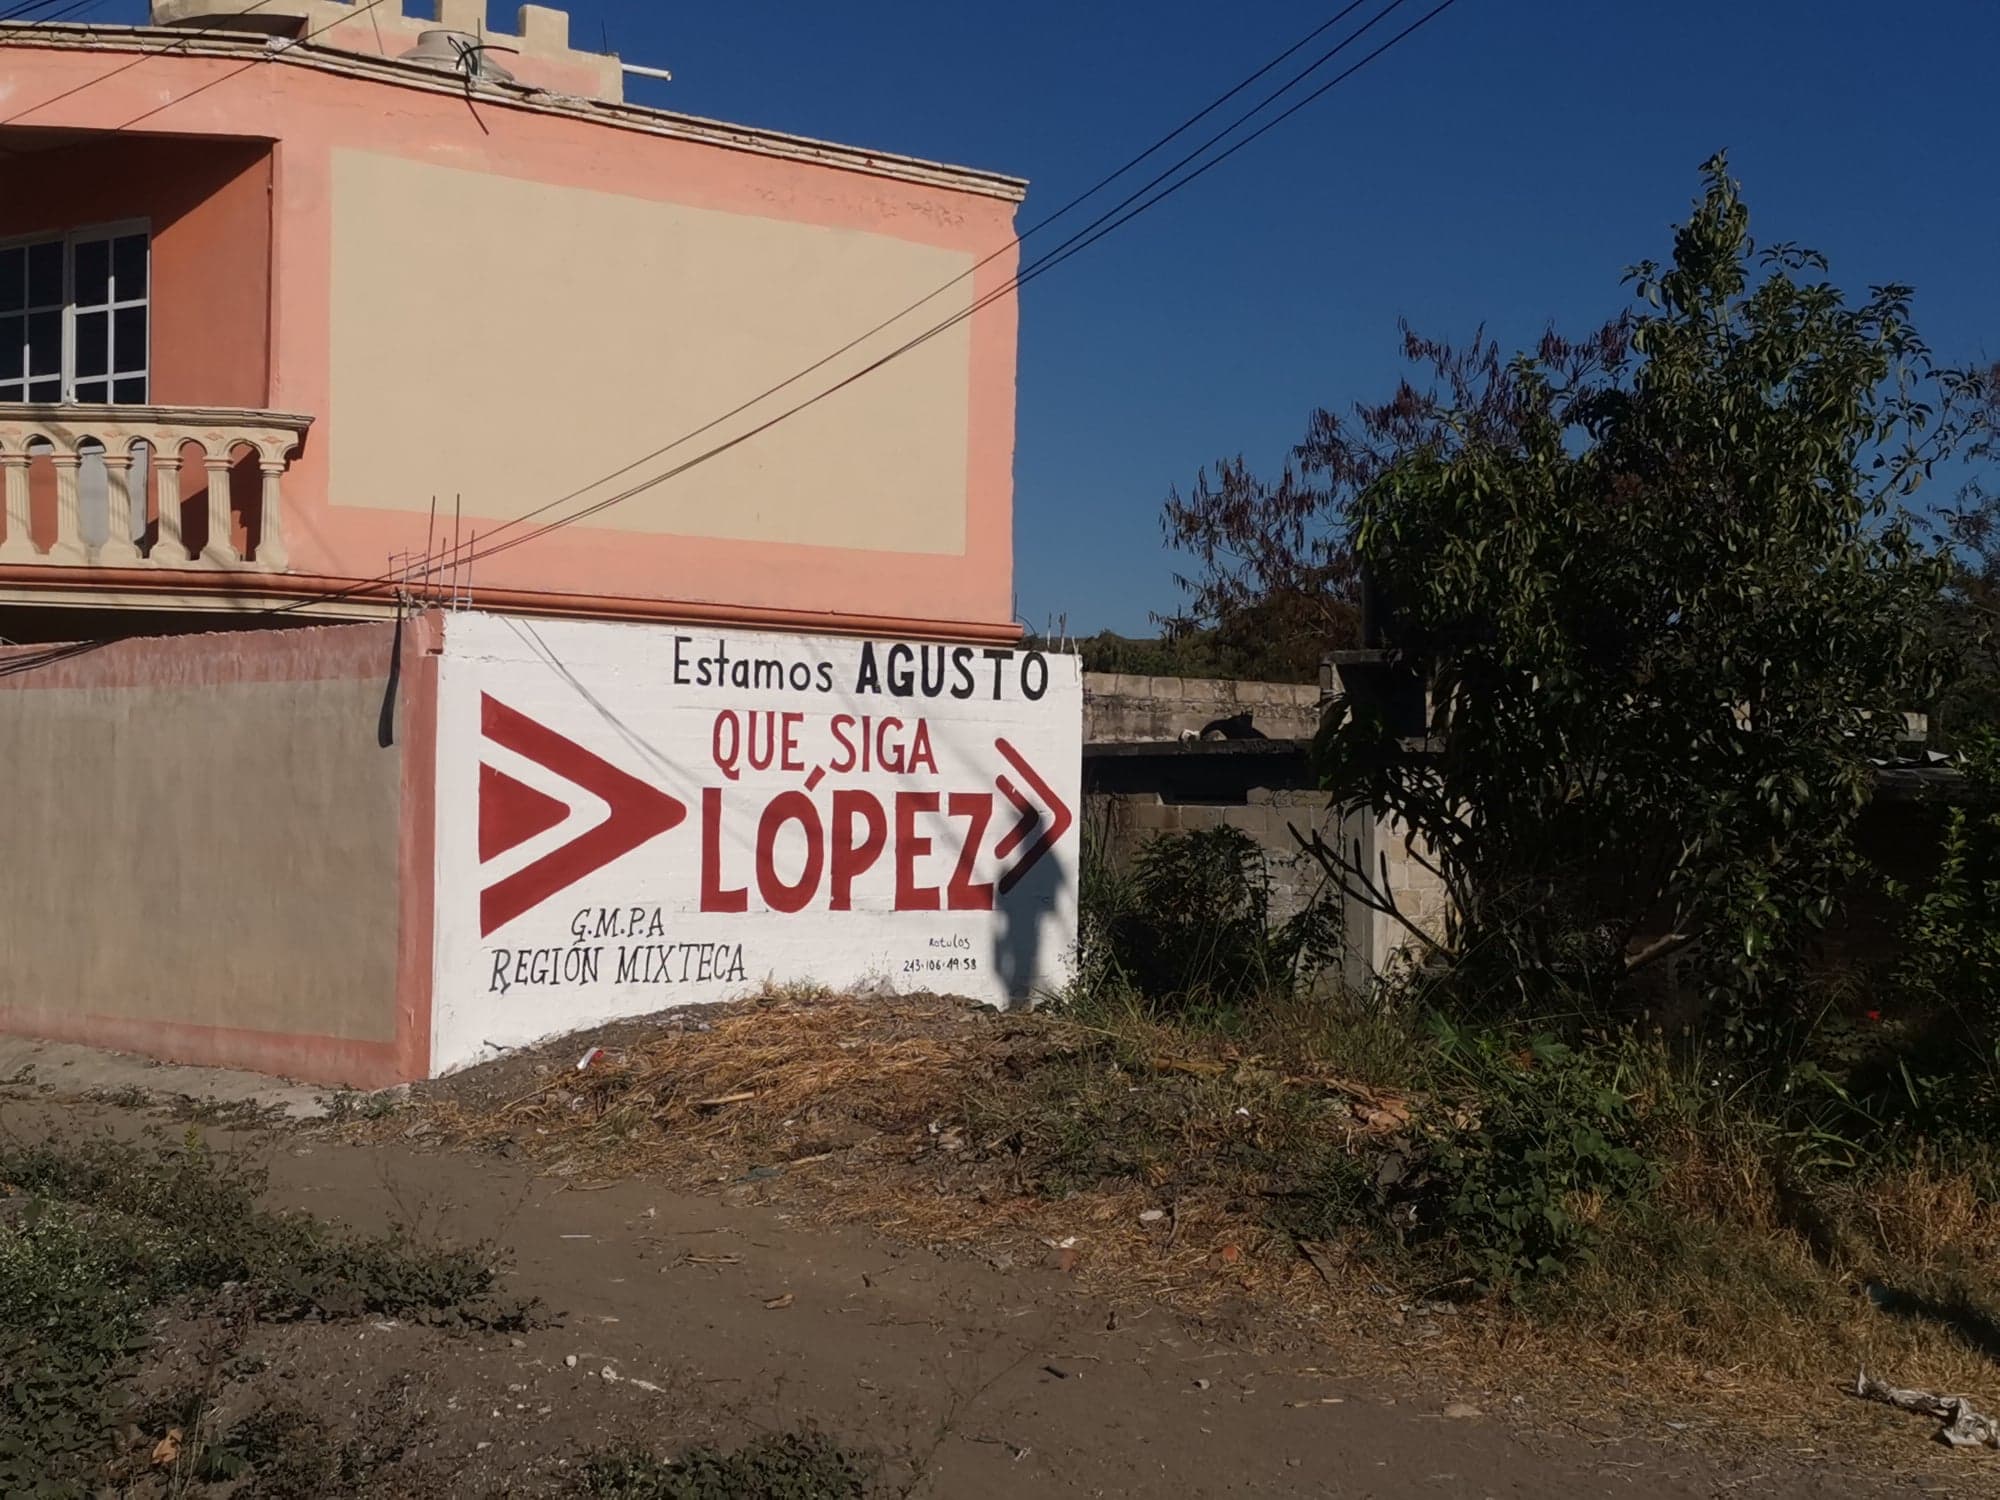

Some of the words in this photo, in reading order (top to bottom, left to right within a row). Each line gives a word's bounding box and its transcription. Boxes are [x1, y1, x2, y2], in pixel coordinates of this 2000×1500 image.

[673, 636, 833, 692] Estamos
[856, 641, 1049, 700] AGUSTO
[713, 710, 805, 780] QUE
[830, 714, 939, 774] SIGA
[700, 766, 994, 913] LÓPEZ
[571, 907, 665, 942] G.M.P.A
[489, 940, 603, 994] REGIÓN
[615, 943, 748, 984] MIXTECA
